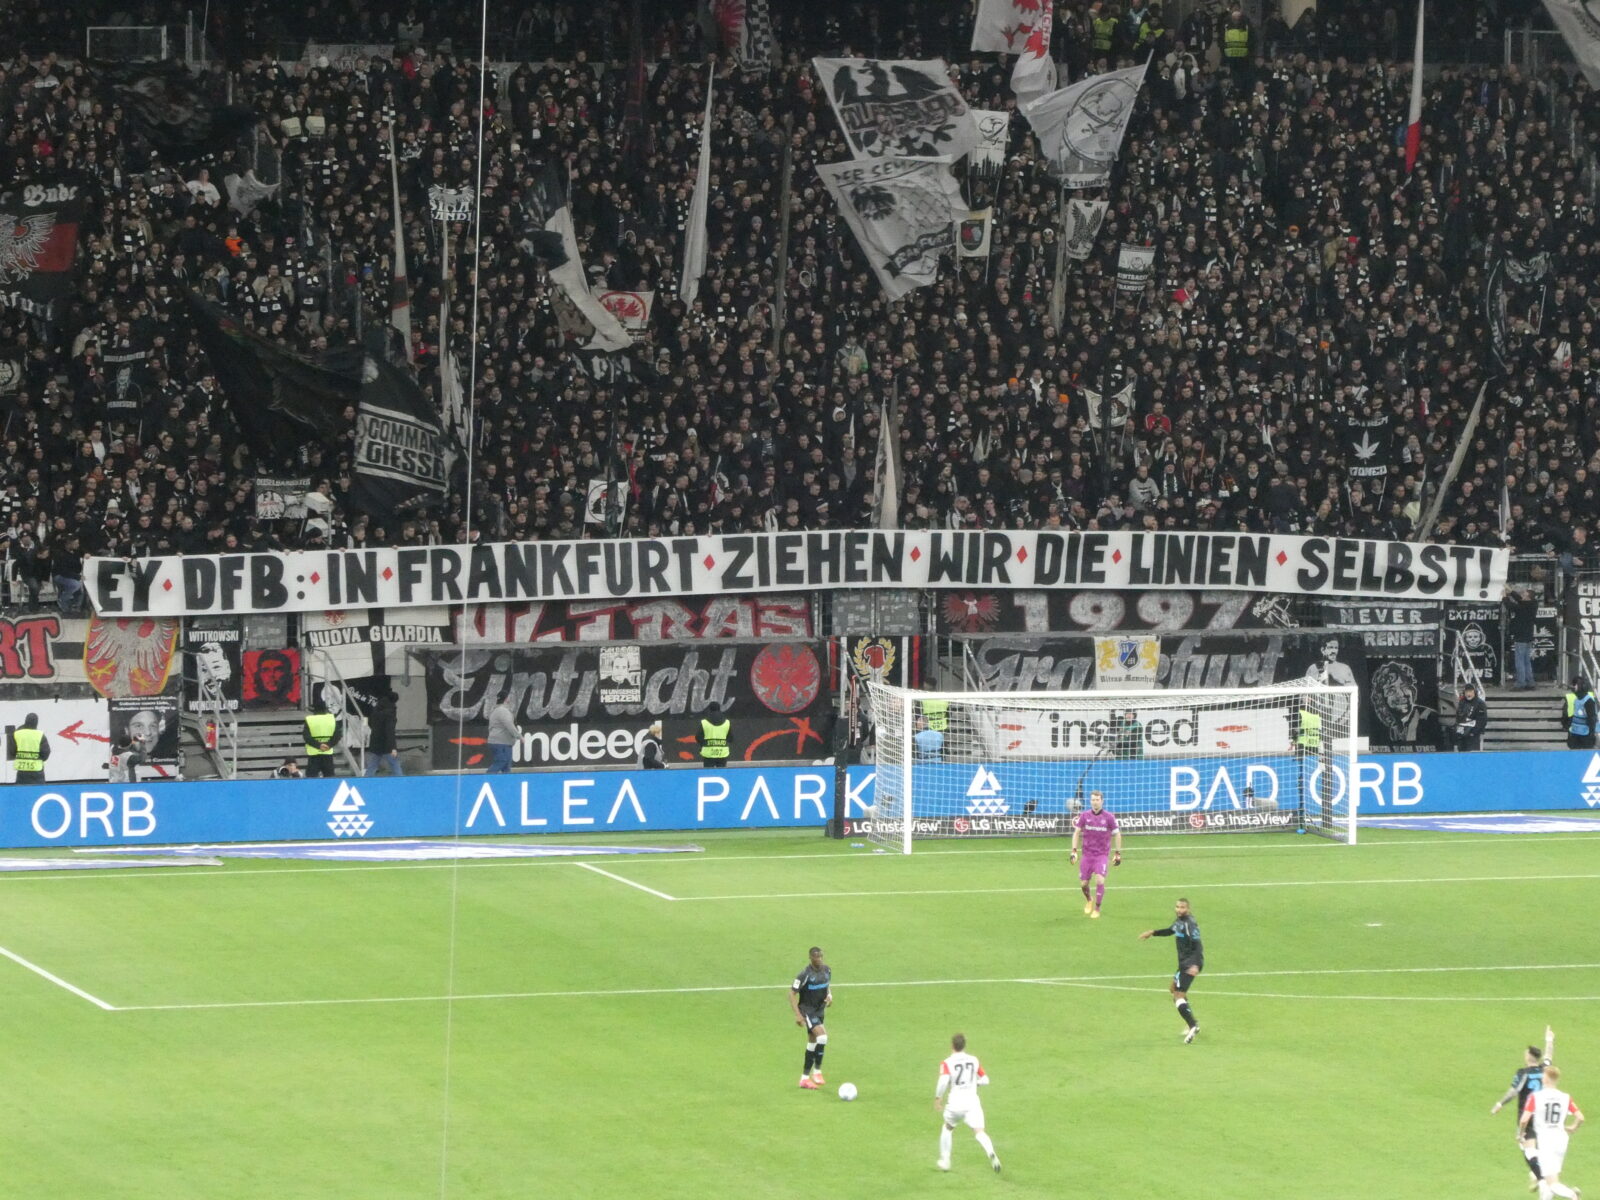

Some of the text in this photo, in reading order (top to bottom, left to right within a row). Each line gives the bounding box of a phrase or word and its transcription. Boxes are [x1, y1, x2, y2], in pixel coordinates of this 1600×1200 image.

[97, 532, 1493, 612] EY DFB: IN FRANKFURT ZIEHEN WIR DIE LINIEN SELBST!
[1012, 590, 1253, 633] 1997
[1340, 608, 1422, 624] NEVER
[1448, 609, 1499, 621] EXTREME
[188, 630, 239, 642] WITTKOWSKI
[309, 625, 443, 647] NUOVA GUARDIA
[438, 647, 738, 721] Eintrcht
[1049, 708, 1199, 748] inded
[1169, 761, 1424, 811] BAD ORB
[465, 770, 878, 828] ALEA PARK
[31, 791, 158, 839] ORB
[971, 817, 1057, 831] LG InstaView
[1114, 814, 1175, 828] nstaView
[1206, 813, 1291, 826] LG InstaView
[853, 822, 872, 834] LG
[954, 1062, 975, 1086] 27
[1544, 1102, 1561, 1124] 16
